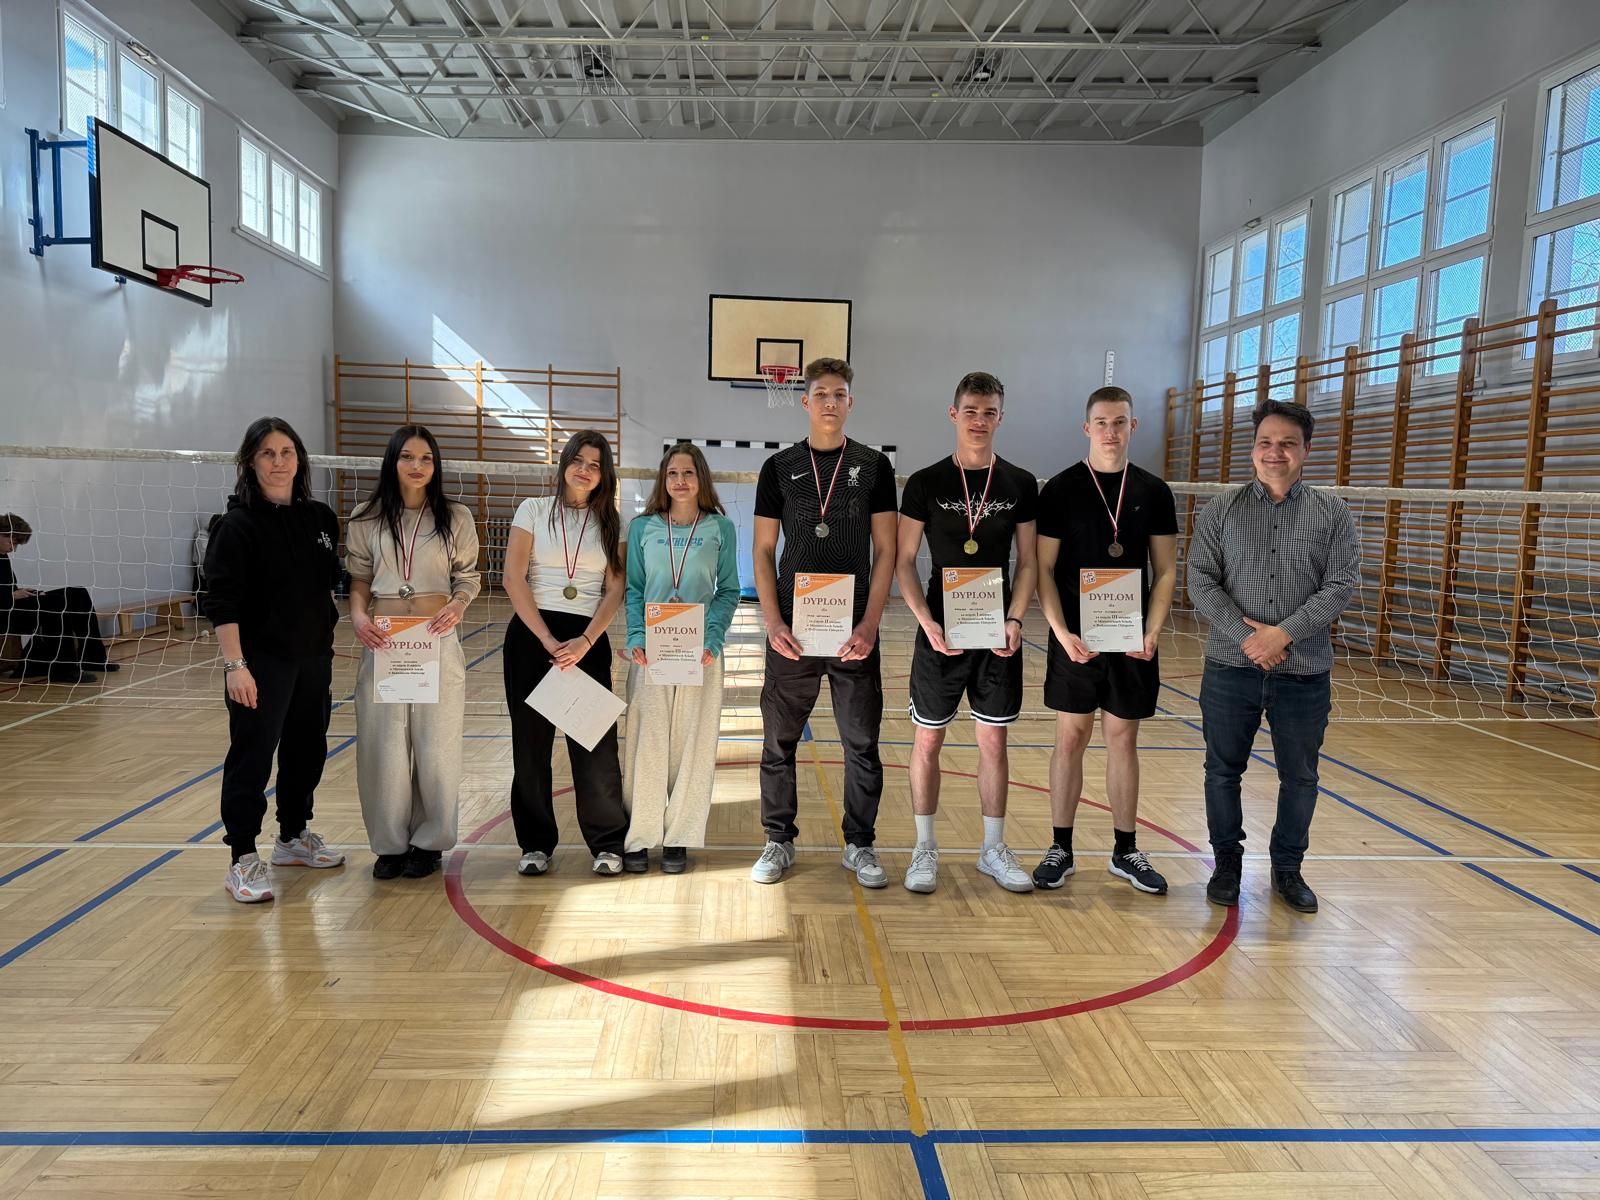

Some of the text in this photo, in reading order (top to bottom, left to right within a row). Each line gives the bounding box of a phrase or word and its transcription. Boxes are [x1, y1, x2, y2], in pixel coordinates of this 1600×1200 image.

[952, 591, 996, 599] DYPLOM
[1089, 592, 1135, 601] DYPLOM
[803, 597, 847, 606] DYPLOM
[654, 626, 697, 635] DYPLOM
[385, 641, 433, 650] DYPLOM
